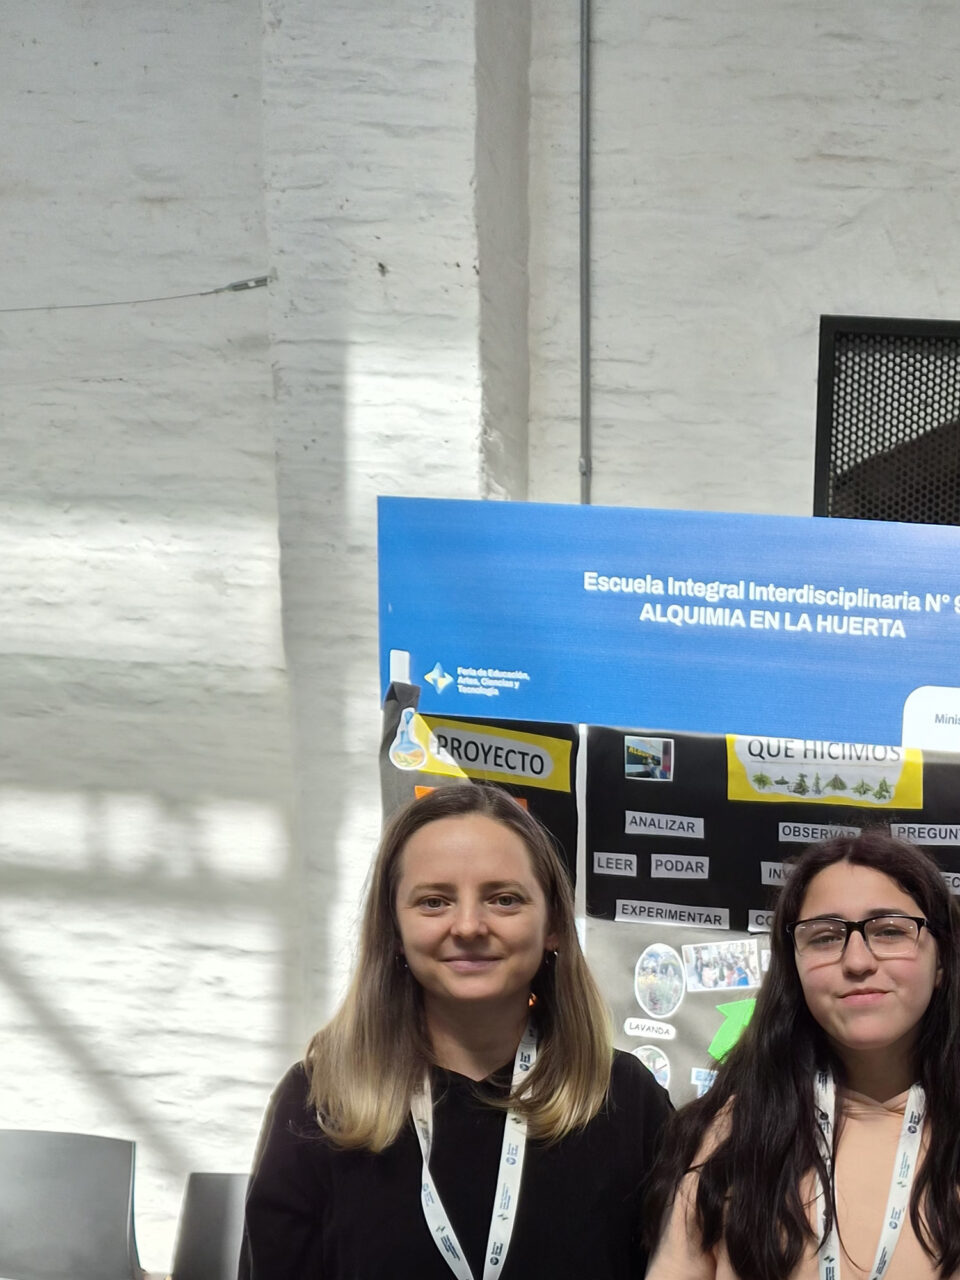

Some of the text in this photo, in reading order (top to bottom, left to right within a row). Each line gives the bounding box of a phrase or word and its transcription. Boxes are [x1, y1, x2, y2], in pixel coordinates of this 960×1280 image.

[583, 571, 664, 595] Escuela
[667, 575, 745, 602] Integral
[749, 580, 921, 612] Interdisciplinaria
[639, 603, 906, 638] ALQUIMIA EN LA HUERTA
[437, 734, 545, 775] PROYECTO
[629, 815, 696, 833] ANALIZAR
[597, 856, 633, 872] LEER
[655, 858, 705, 874] PODAR
[621, 903, 722, 926] EXPERIMENTAR
[629, 1022, 671, 1035] LAVANDA
